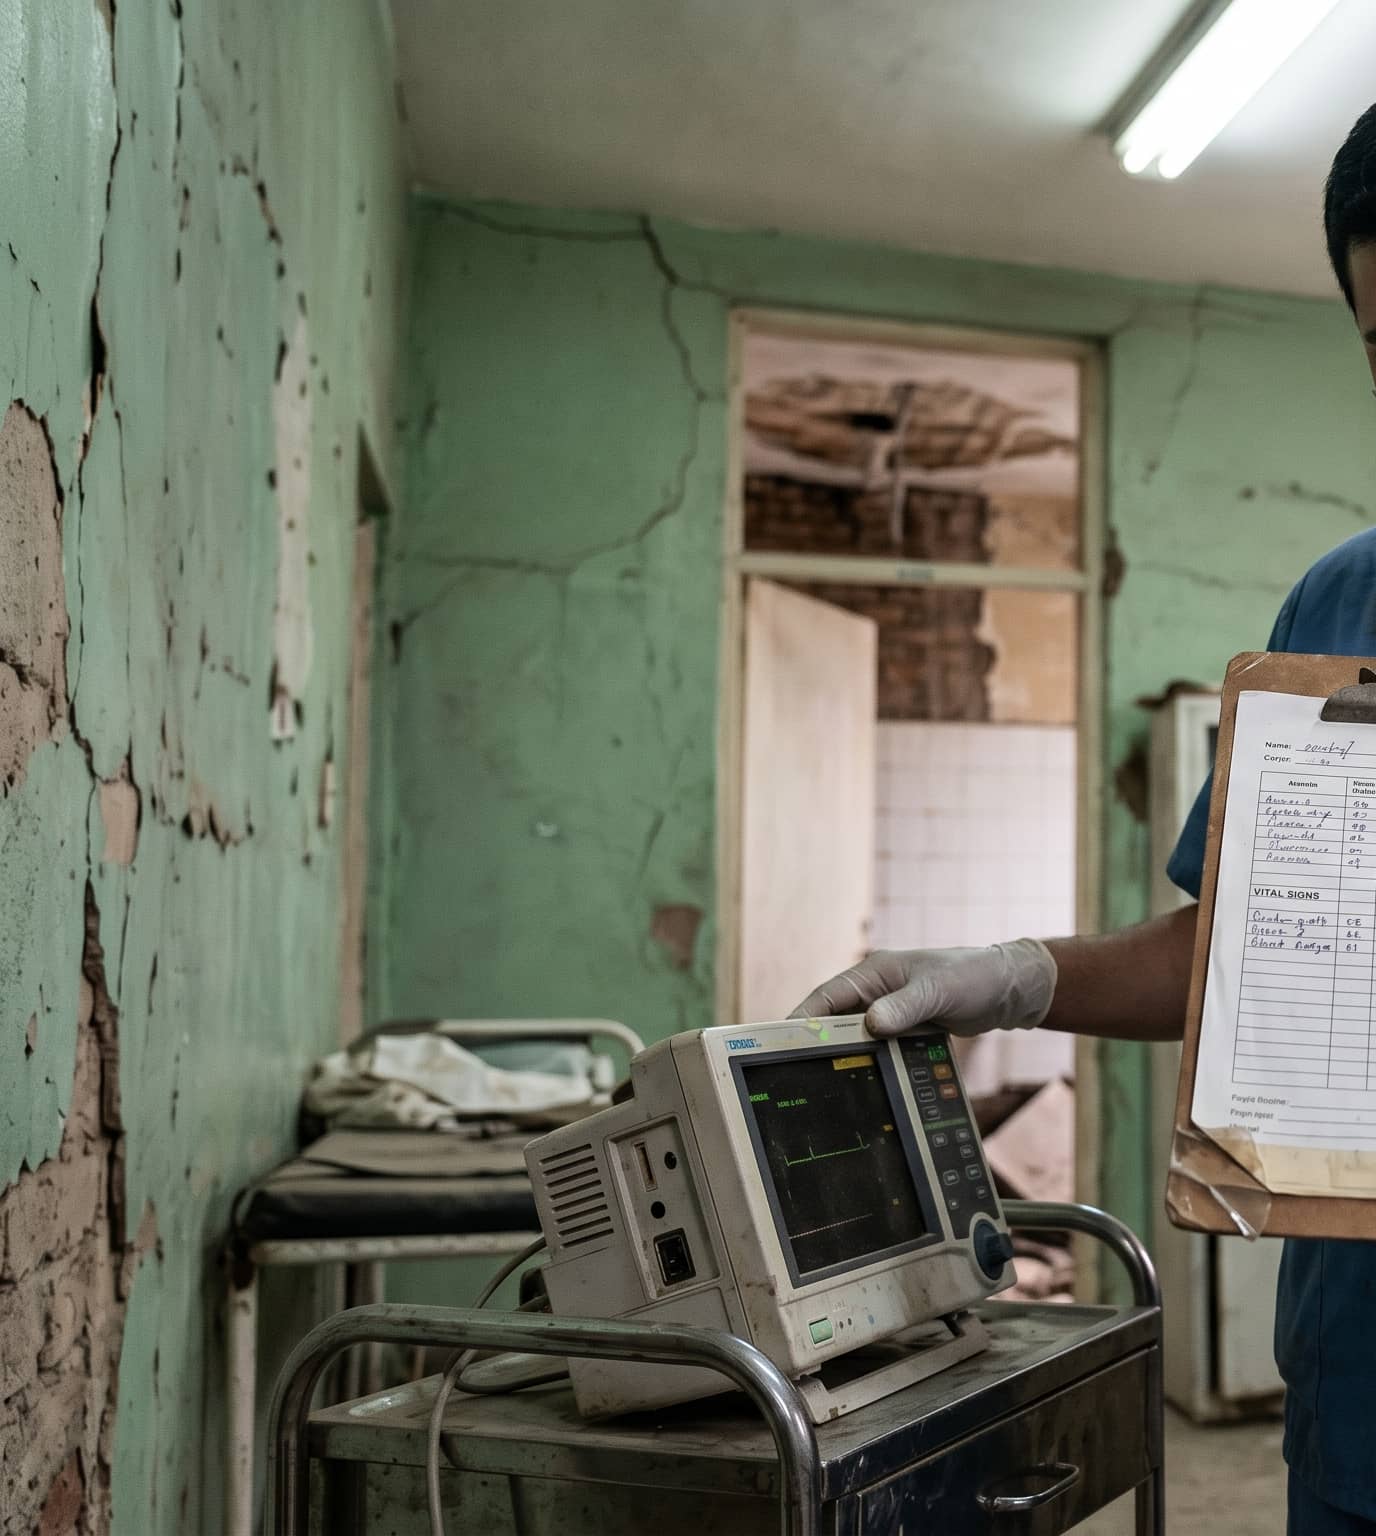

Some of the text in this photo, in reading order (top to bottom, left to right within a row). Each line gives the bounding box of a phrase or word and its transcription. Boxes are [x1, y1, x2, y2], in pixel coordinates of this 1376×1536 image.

[1265, 741, 1292, 751] Name:
[1254, 888, 1320, 900] VITAL SIGNS
